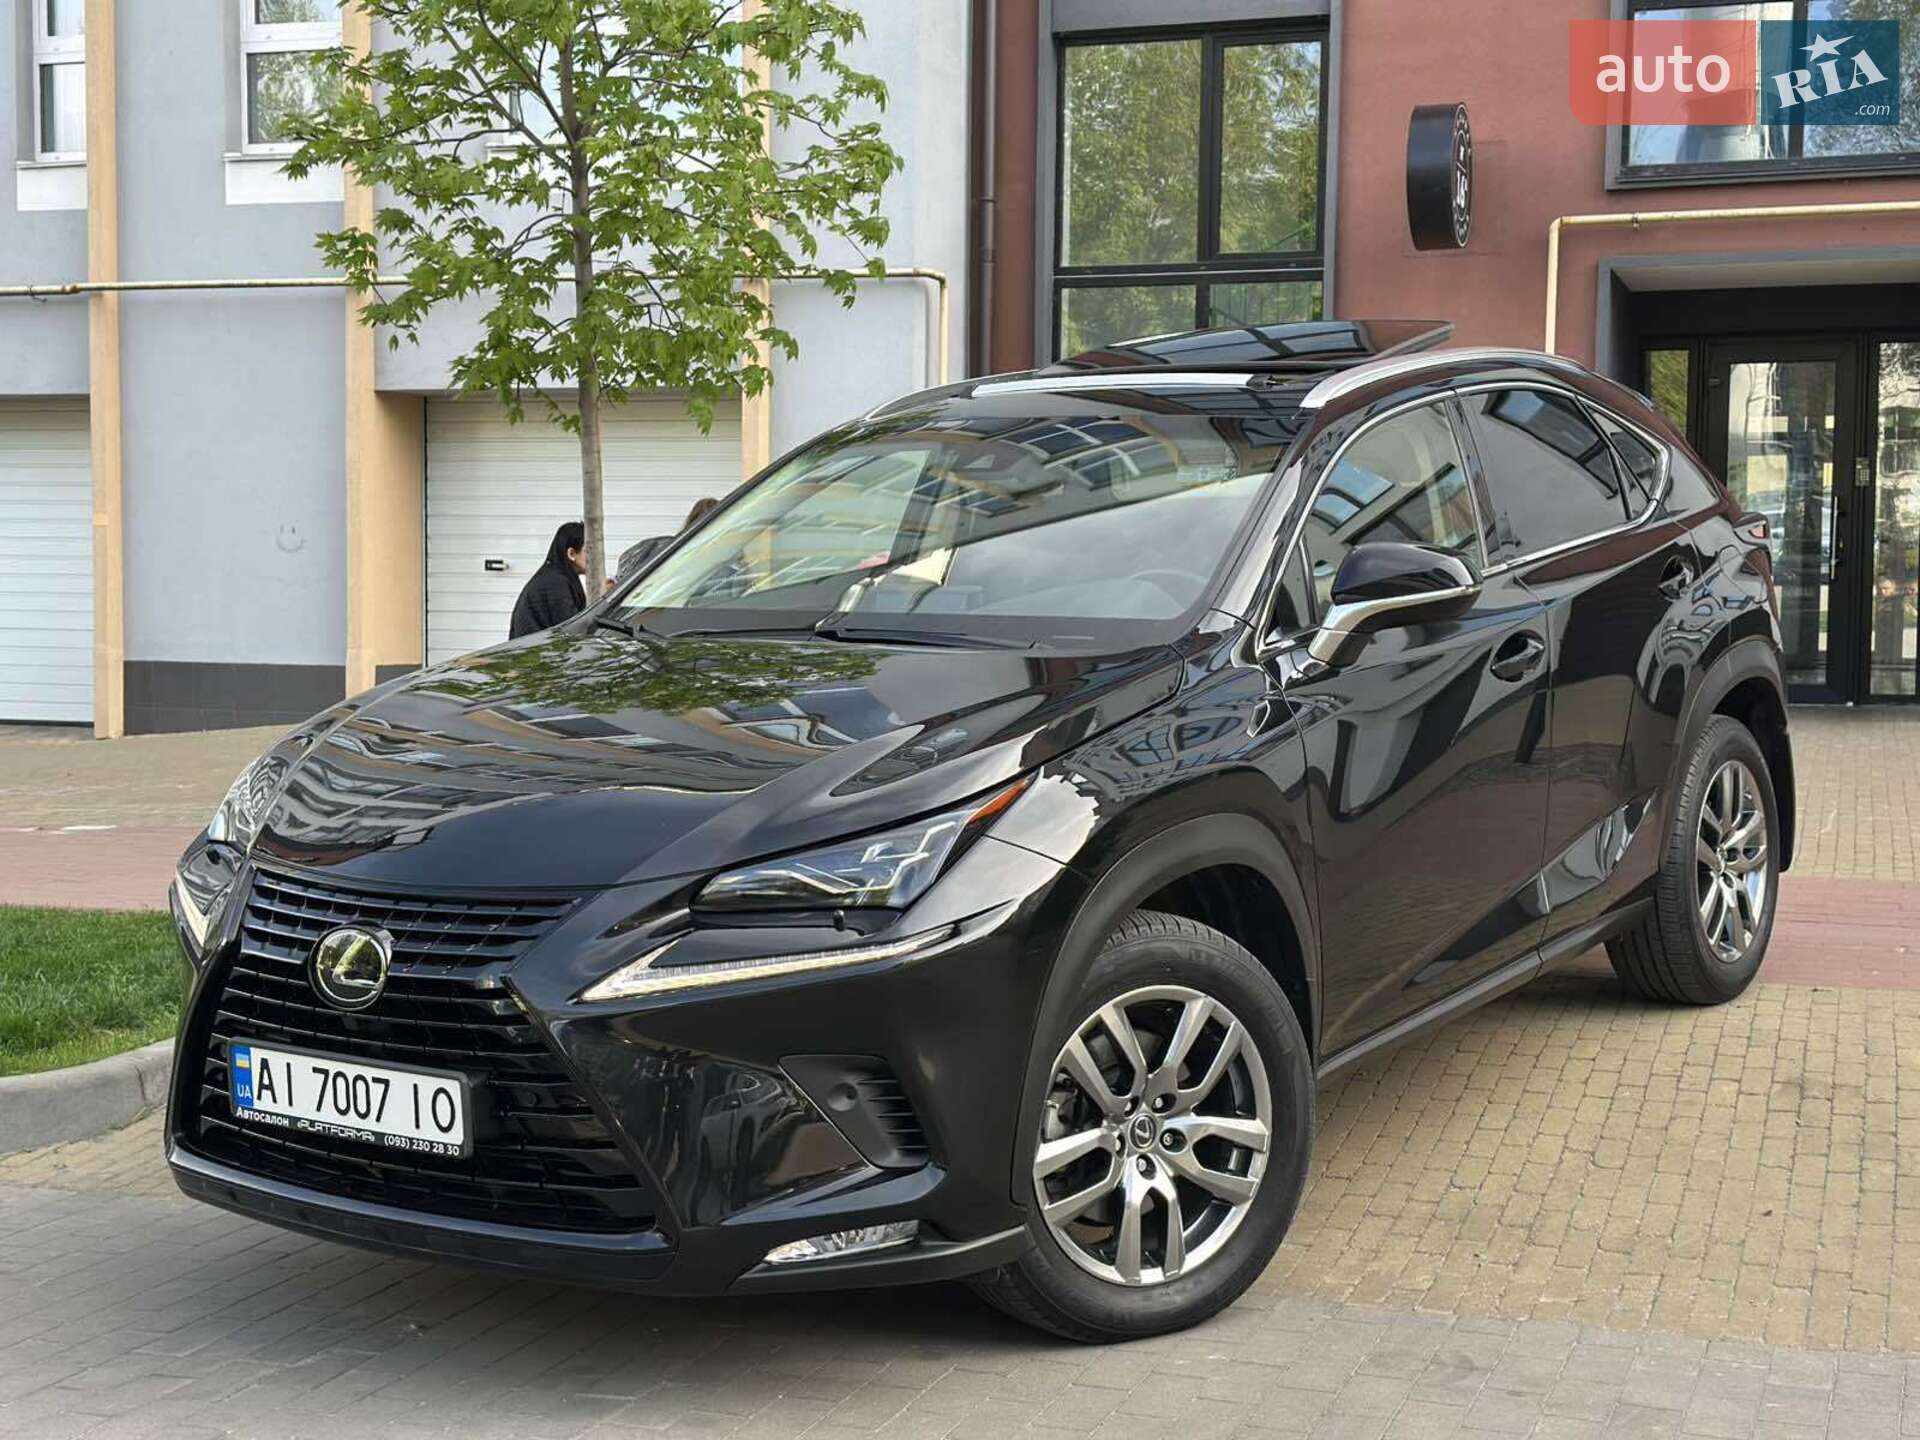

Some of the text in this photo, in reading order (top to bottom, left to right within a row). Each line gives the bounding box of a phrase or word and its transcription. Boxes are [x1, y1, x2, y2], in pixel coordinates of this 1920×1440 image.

[237, 1083, 252, 1099] UA
[257, 1057, 456, 1133] AI 7007 IO
[236, 1107, 289, 1127] Автосалон
[384, 1135, 410, 1150] (093)
[412, 1140, 430, 1152] 230
[432, 1143, 445, 1154] 28
[446, 1145, 460, 1156] 30
